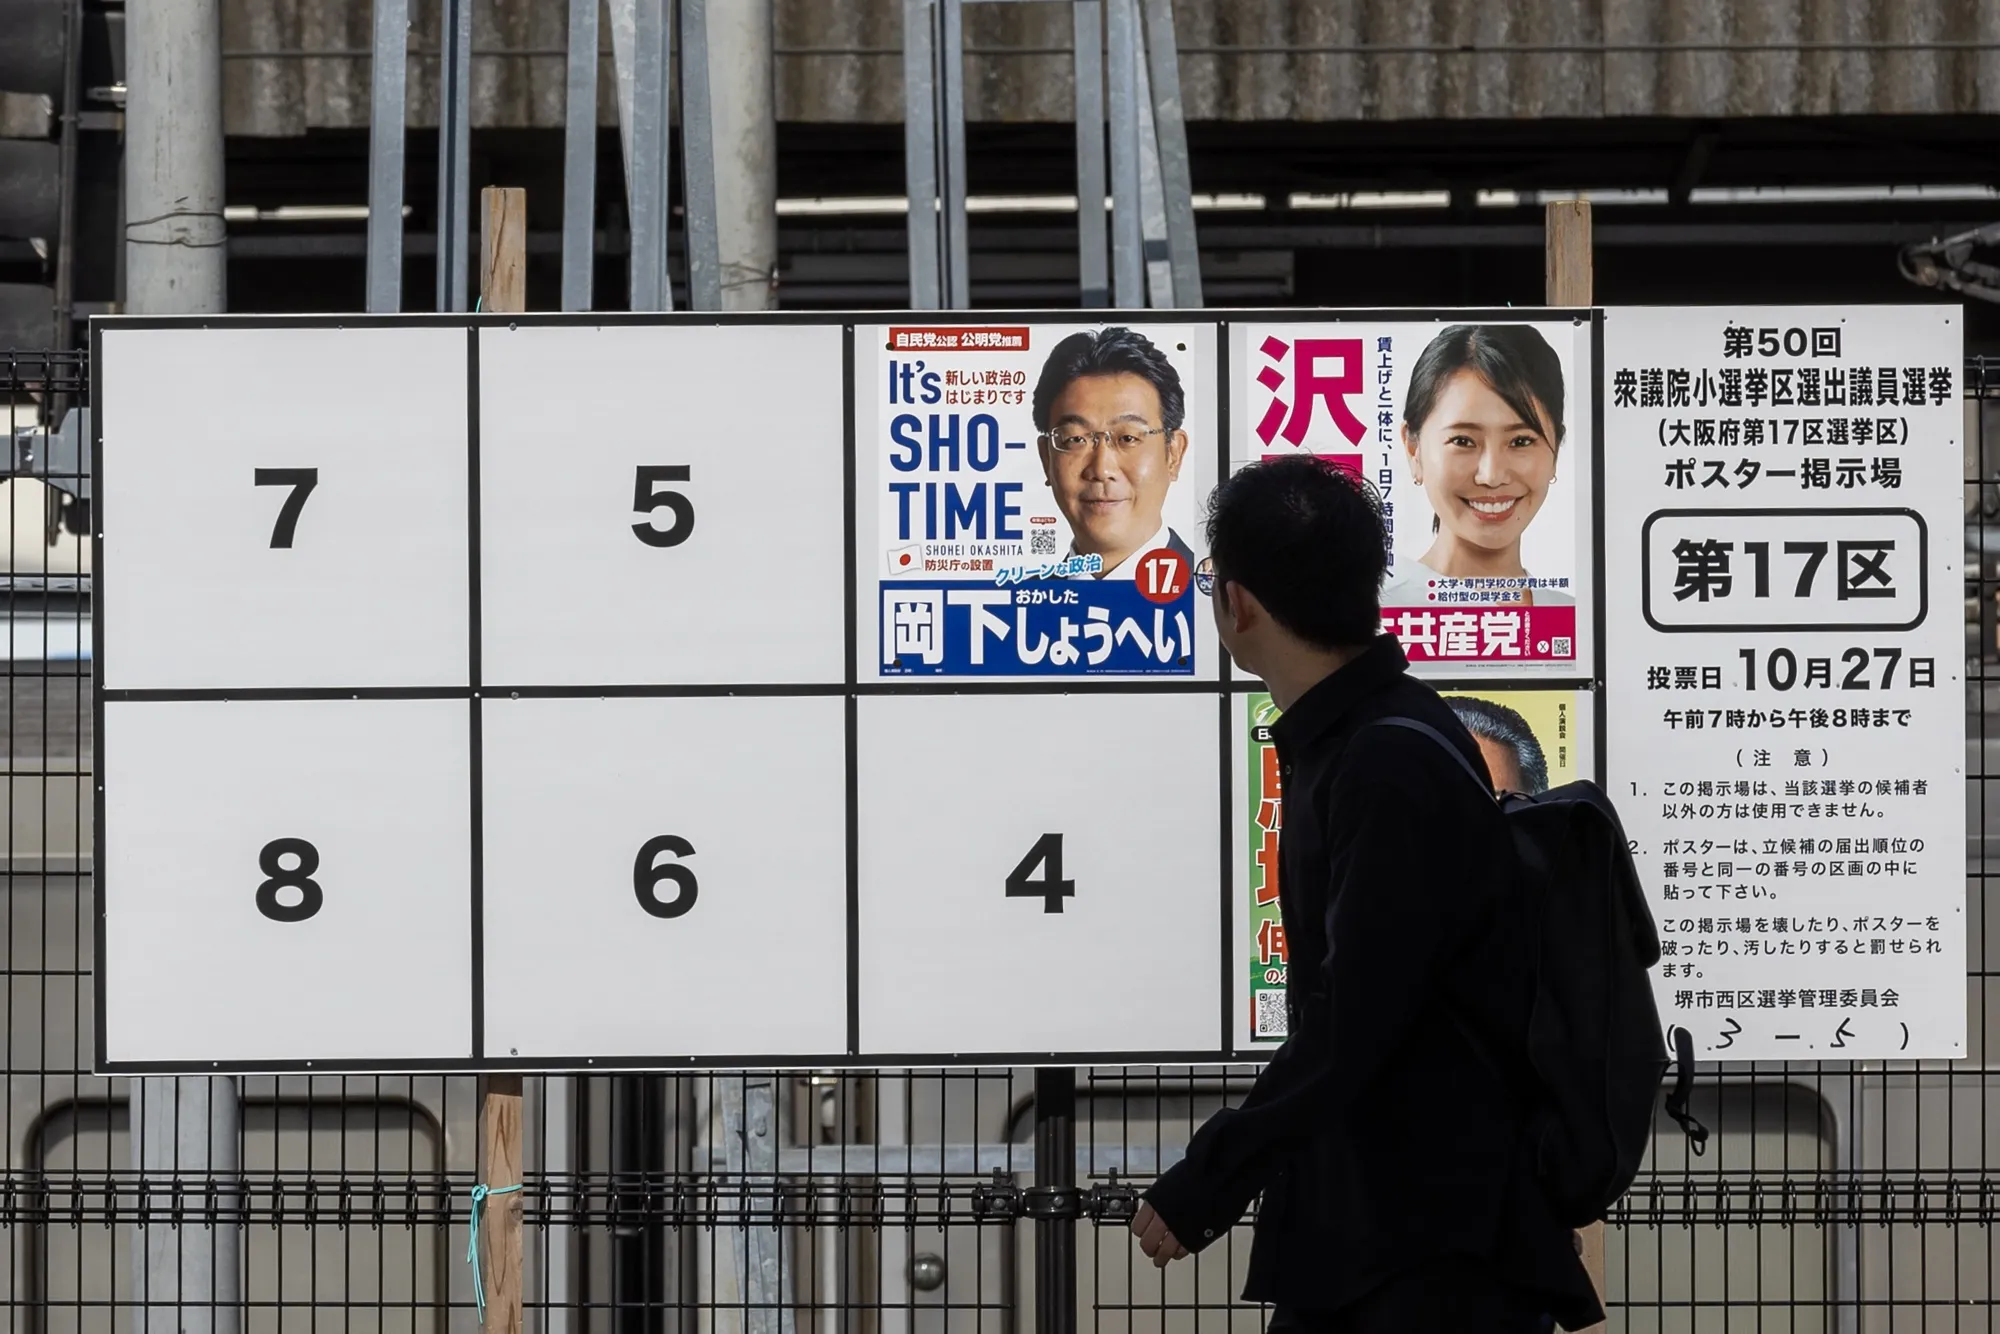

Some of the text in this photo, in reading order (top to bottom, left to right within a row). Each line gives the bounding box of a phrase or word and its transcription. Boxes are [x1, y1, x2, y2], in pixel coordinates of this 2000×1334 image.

[896, 332, 1022, 347] 自民党公認 公明党推薦
[1723, 327, 1841, 358] 第50回
[889, 360, 942, 404] It's
[945, 370, 1026, 386] 新しい政治の
[1614, 367, 1952, 407] 衆議院小選挙区選出議員選挙
[945, 389, 1026, 405] はじまりです
[1659, 417, 1907, 446] (大阪府第17区選挙区)
[890, 413, 1026, 472] SHO-
[1665, 458, 1901, 489] ポスター掲示場
[255, 468, 317, 548] 7
[632, 465, 694, 547] 5
[889, 482, 1024, 541] TIME
[925, 544, 1024, 556] SHOHEI OKASHITA
[924, 559, 994, 572] 防災庁の設置
[995, 555, 1103, 586] クリーンな政治
[1672, 539, 1895, 602] 第17区
[1015, 589, 1079, 605] おかした
[1648, 648, 1934, 691] 投票日 10月27日
[1664, 708, 1911, 729] 午前7時から午後8時まで
[1630, 780, 1927, 797] 1. この掲示場は、当該選挙の候補者
[1663, 803, 1883, 819] 以外の方は使用できません。
[1664, 838, 1924, 855] ポスターは、立候補の届出順位の
[634, 835, 698, 918] 6
[1006, 833, 1075, 913] 4
[1664, 860, 1916, 877] 番号と同一の番号の区画の中に
[256, 838, 323, 922] 8
[1664, 884, 1776, 900] 貼って下さい。
[1664, 916, 1939, 933] この掲示場を壊したり、ポスターを
[1662, 939, 1941, 955] 破ったり、汚したりすると罰せられ
[1663, 963, 1702, 978] ます。
[1675, 989, 1898, 1008] 堺市西区選挙管理委員会
